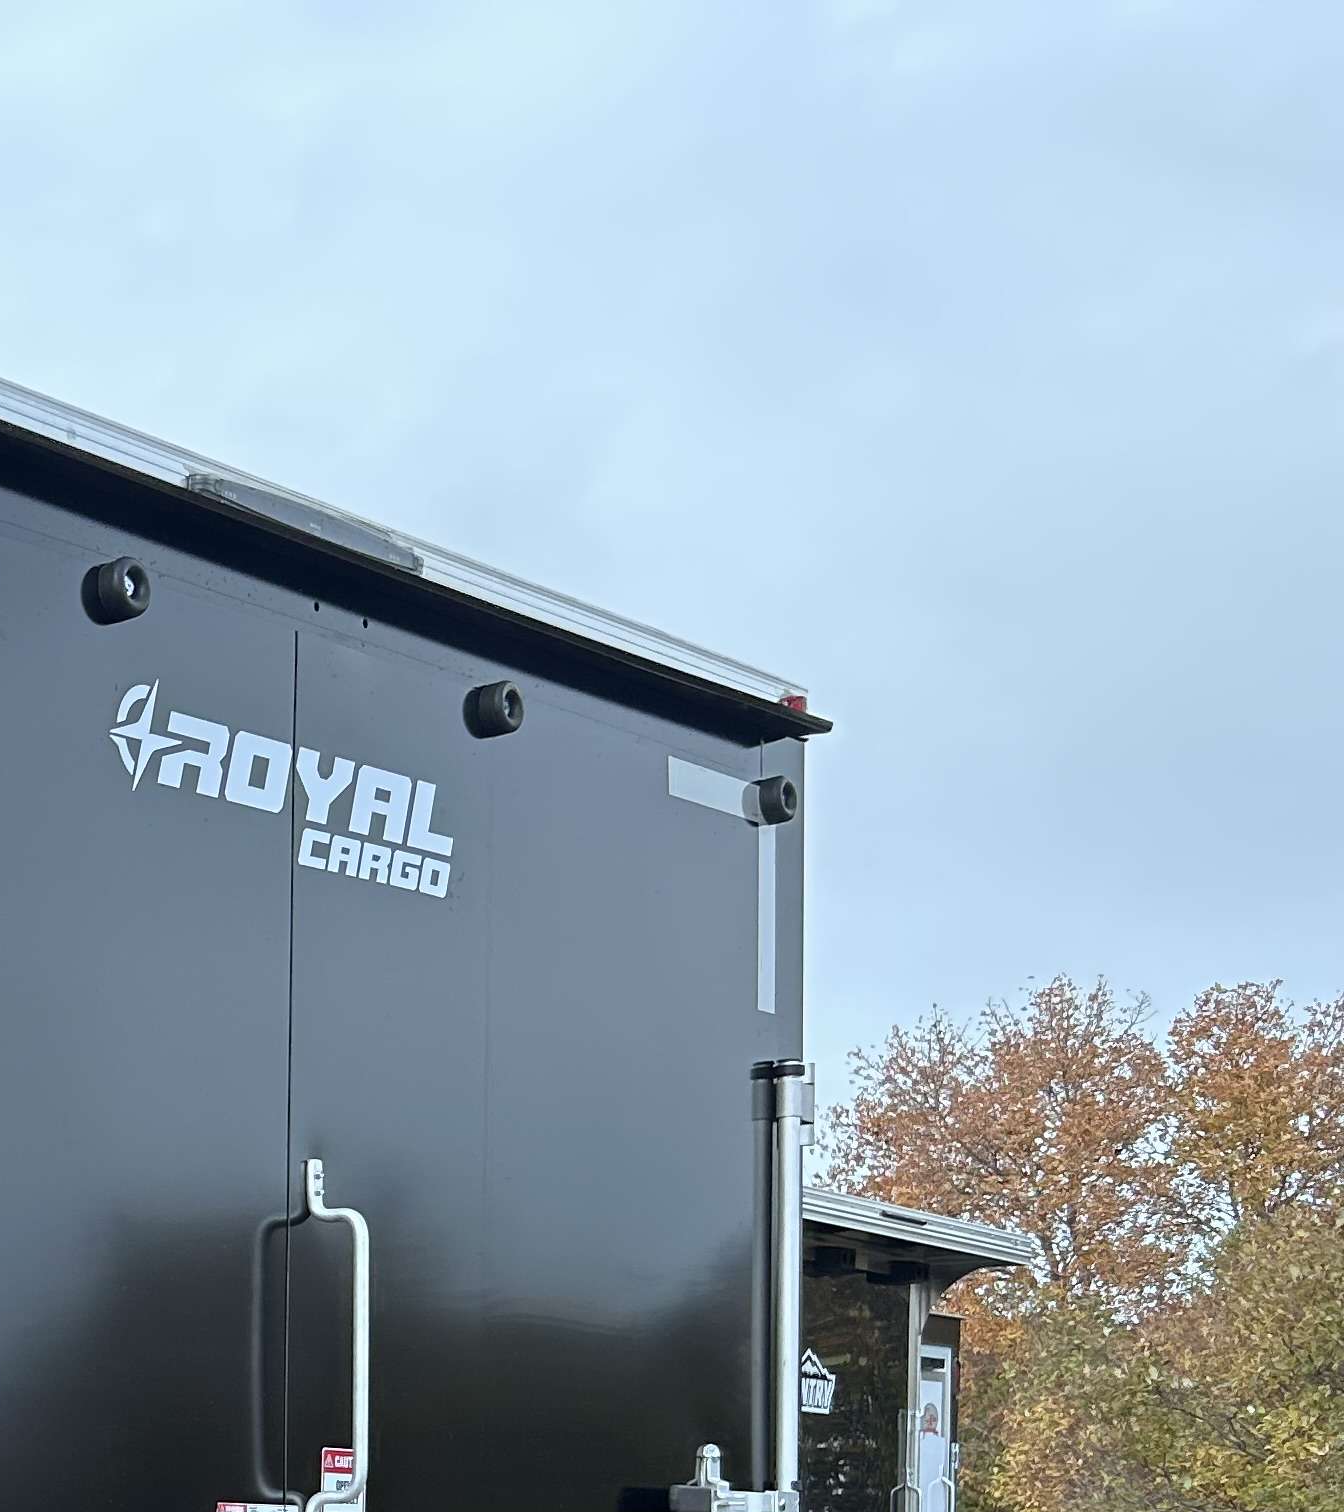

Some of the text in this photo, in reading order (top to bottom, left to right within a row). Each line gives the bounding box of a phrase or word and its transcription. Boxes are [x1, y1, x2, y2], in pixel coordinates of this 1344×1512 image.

[157, 710, 454, 857] ROYAL
[298, 828, 451, 898] CARGO
[334, 1455, 354, 1468] CAUT
